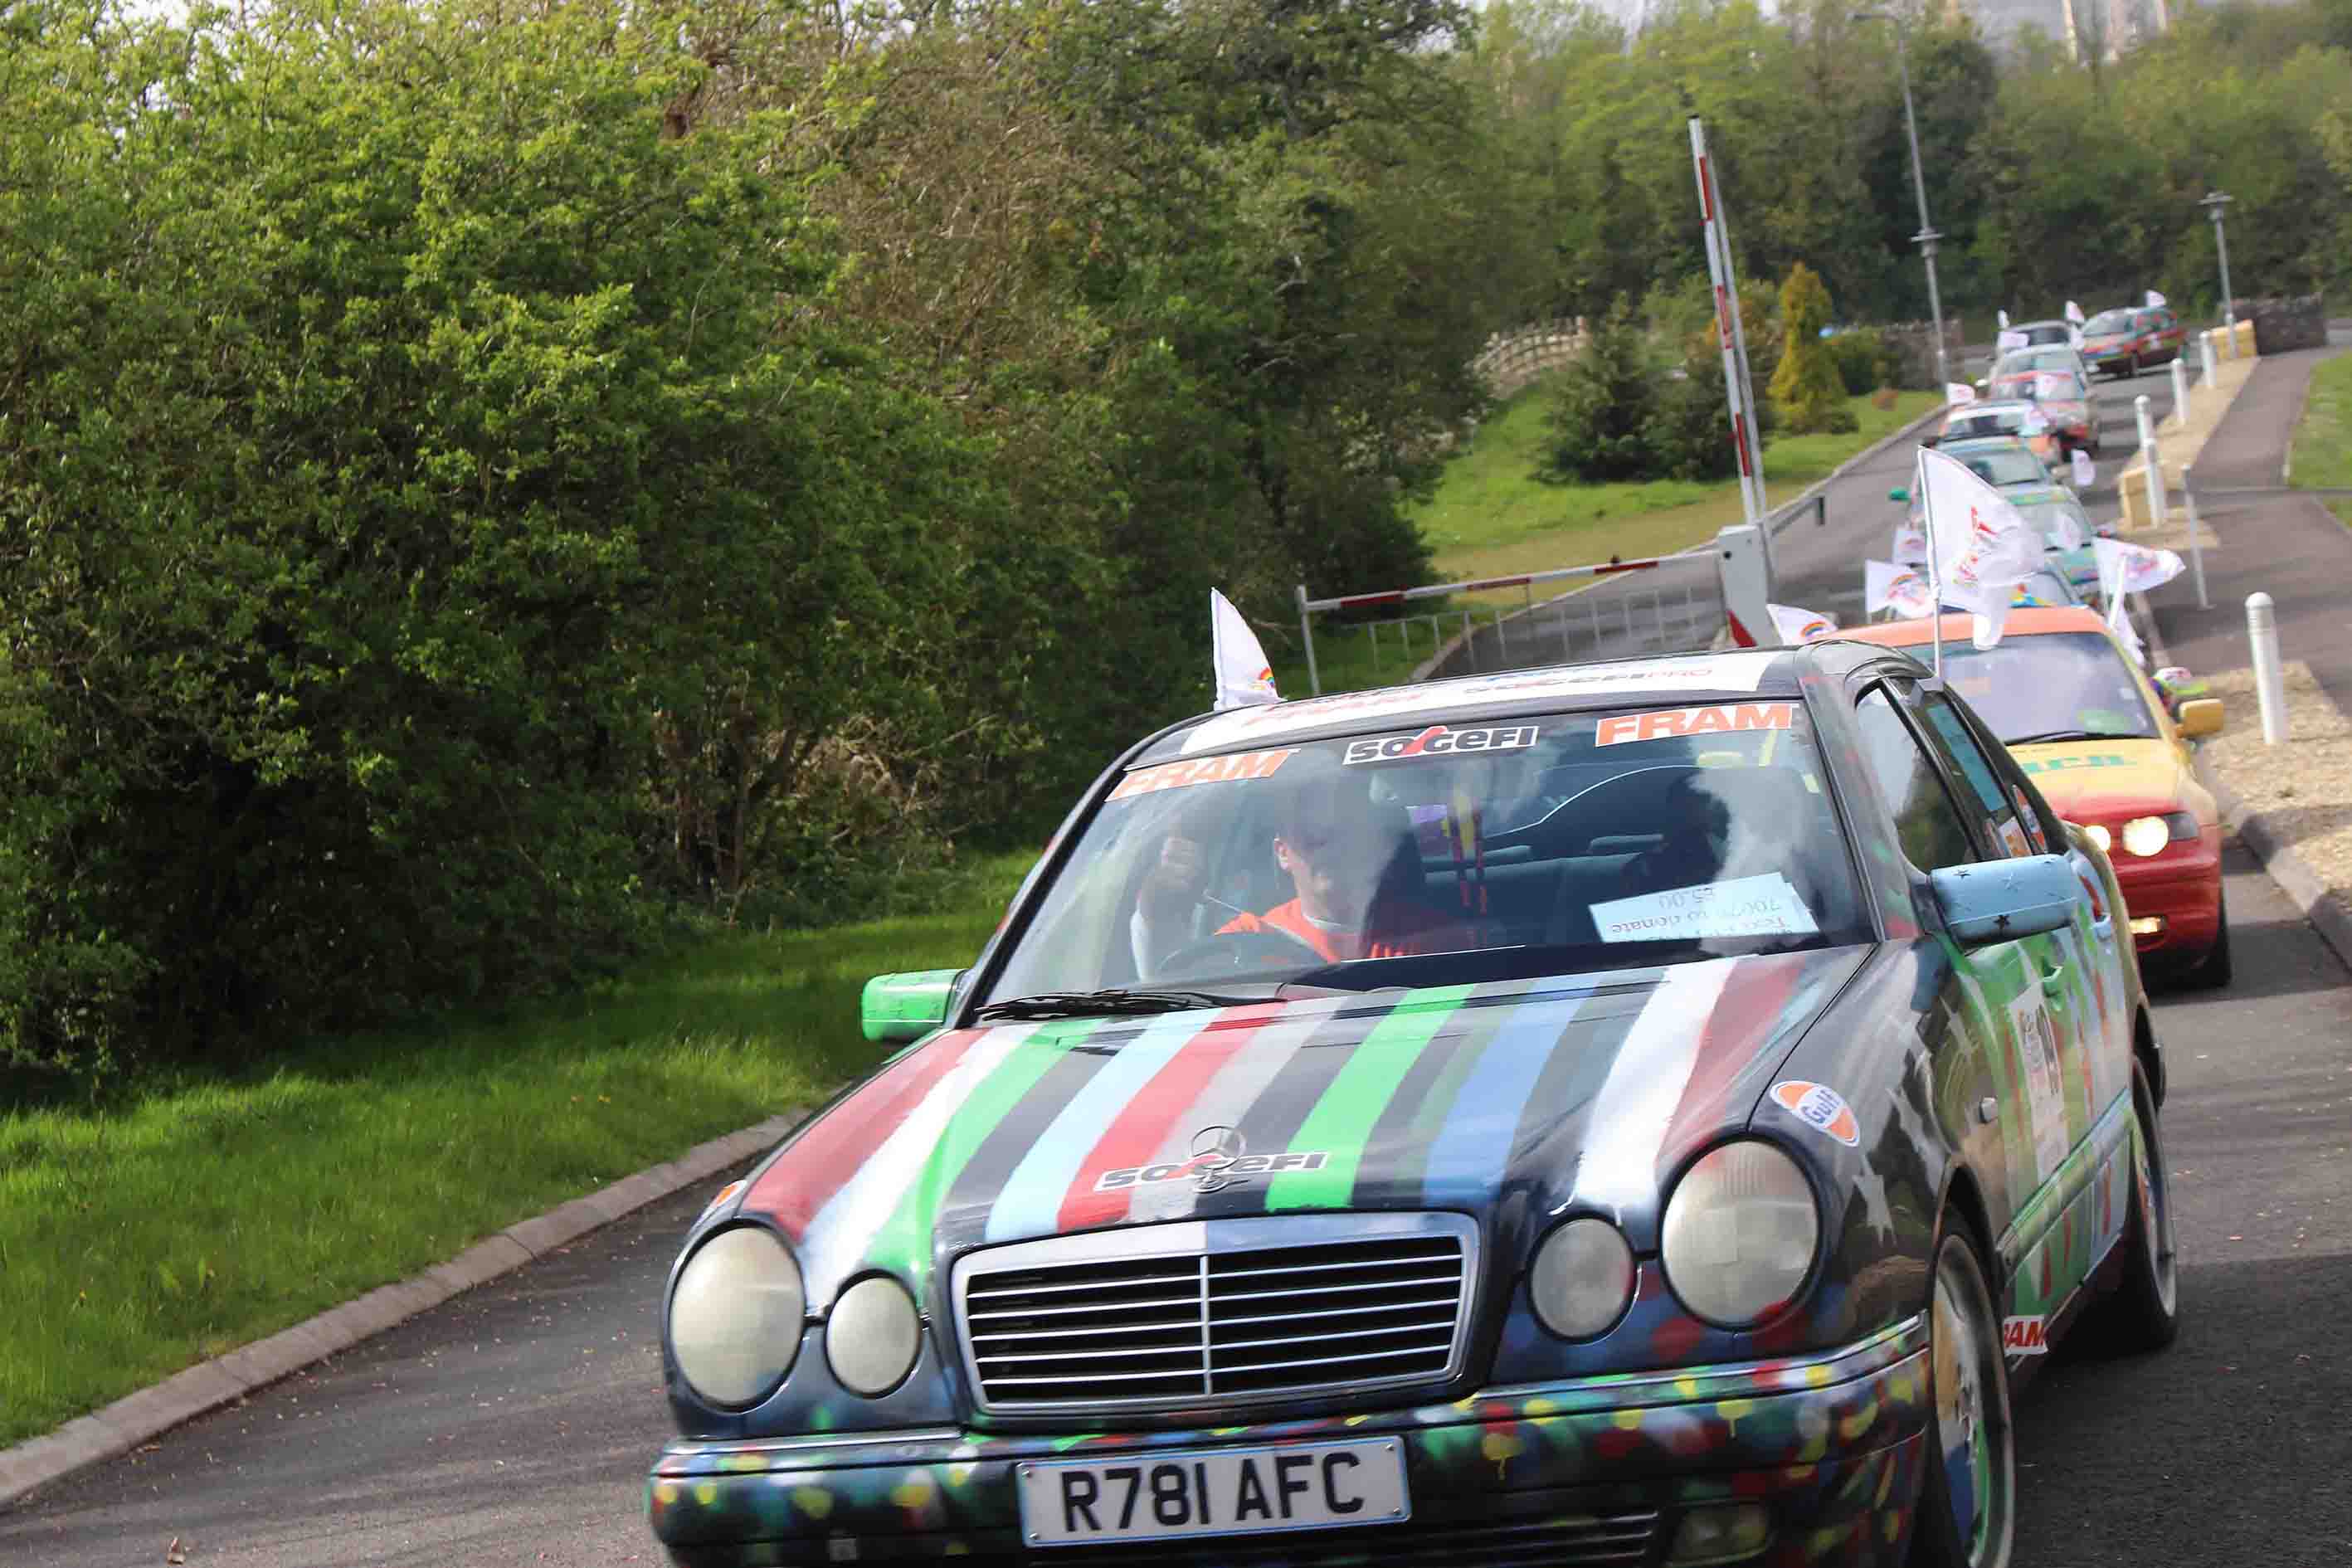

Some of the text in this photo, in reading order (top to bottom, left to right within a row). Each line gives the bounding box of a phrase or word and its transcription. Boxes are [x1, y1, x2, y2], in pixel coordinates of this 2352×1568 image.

[1600, 705, 1791, 745] FRAM
[1061, 1451, 1365, 1532] R781 AFC
